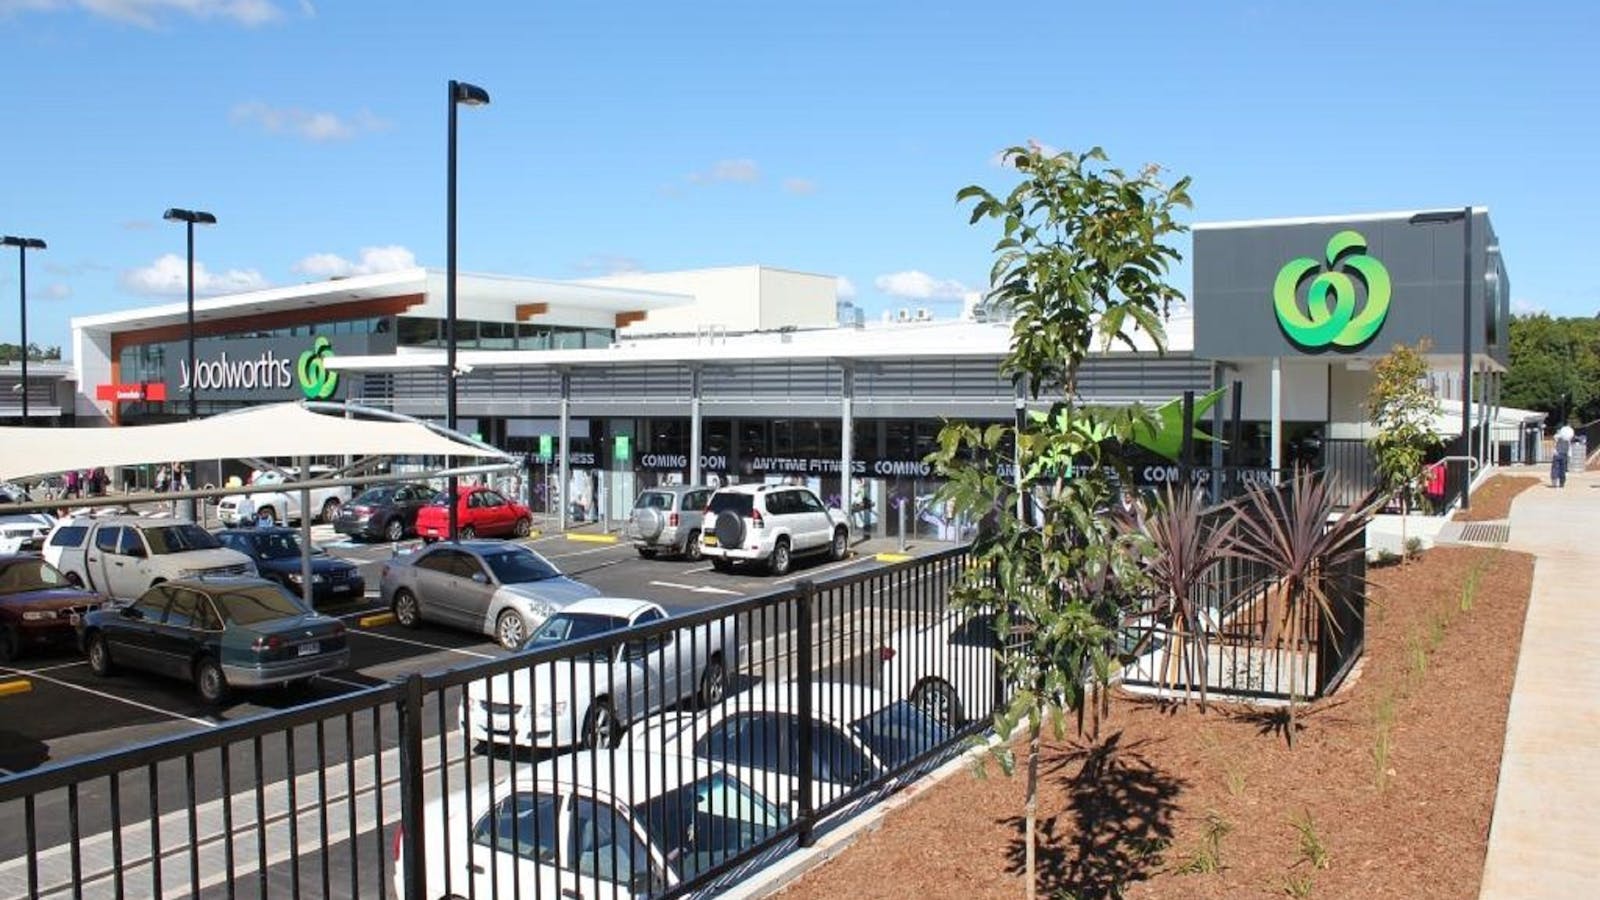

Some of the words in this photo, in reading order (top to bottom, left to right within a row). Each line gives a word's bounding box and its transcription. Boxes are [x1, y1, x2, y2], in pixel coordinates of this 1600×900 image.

[179, 350, 292, 389] Woolworths
[641, 454, 687, 468] COMING
[699, 455, 726, 469] OON
[752, 457, 807, 472] ANYTIME
[874, 460, 931, 476] COMING
